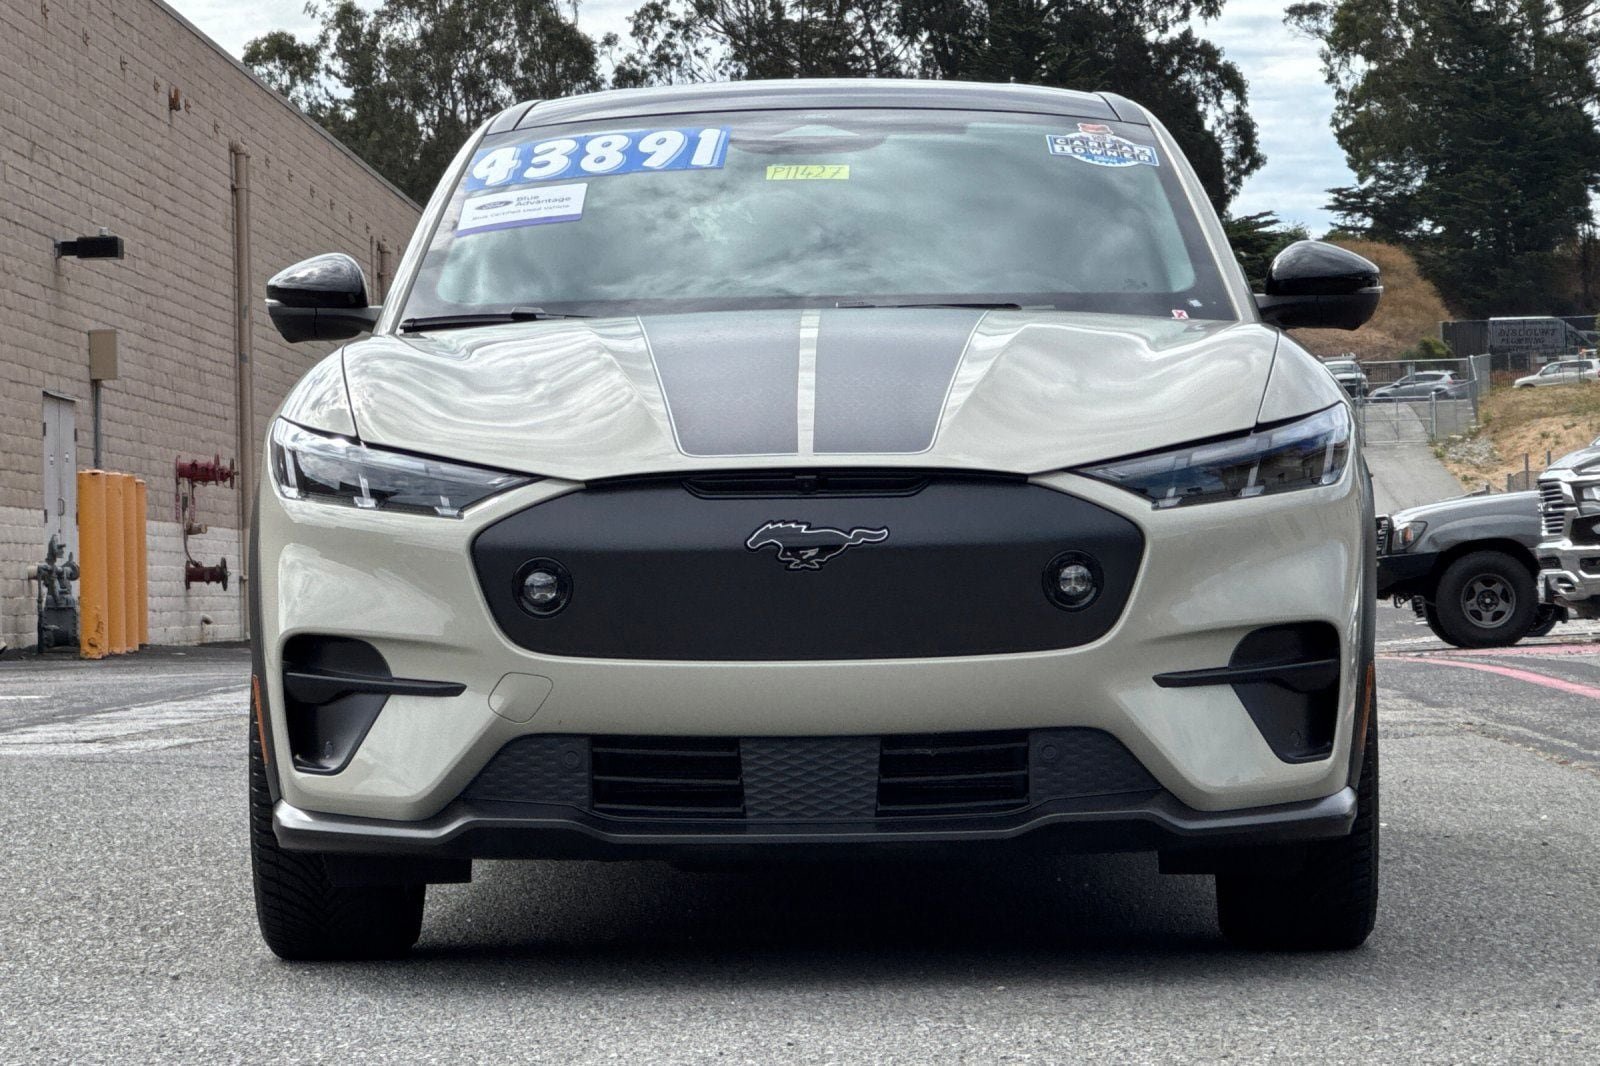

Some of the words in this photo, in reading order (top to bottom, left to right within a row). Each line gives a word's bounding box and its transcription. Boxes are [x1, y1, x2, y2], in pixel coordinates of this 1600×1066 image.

[472, 128, 724, 186] 43891
[1073, 147, 1150, 162] OWNER
[771, 166, 845, 179] P11427
[515, 196, 571, 207] Advantage
